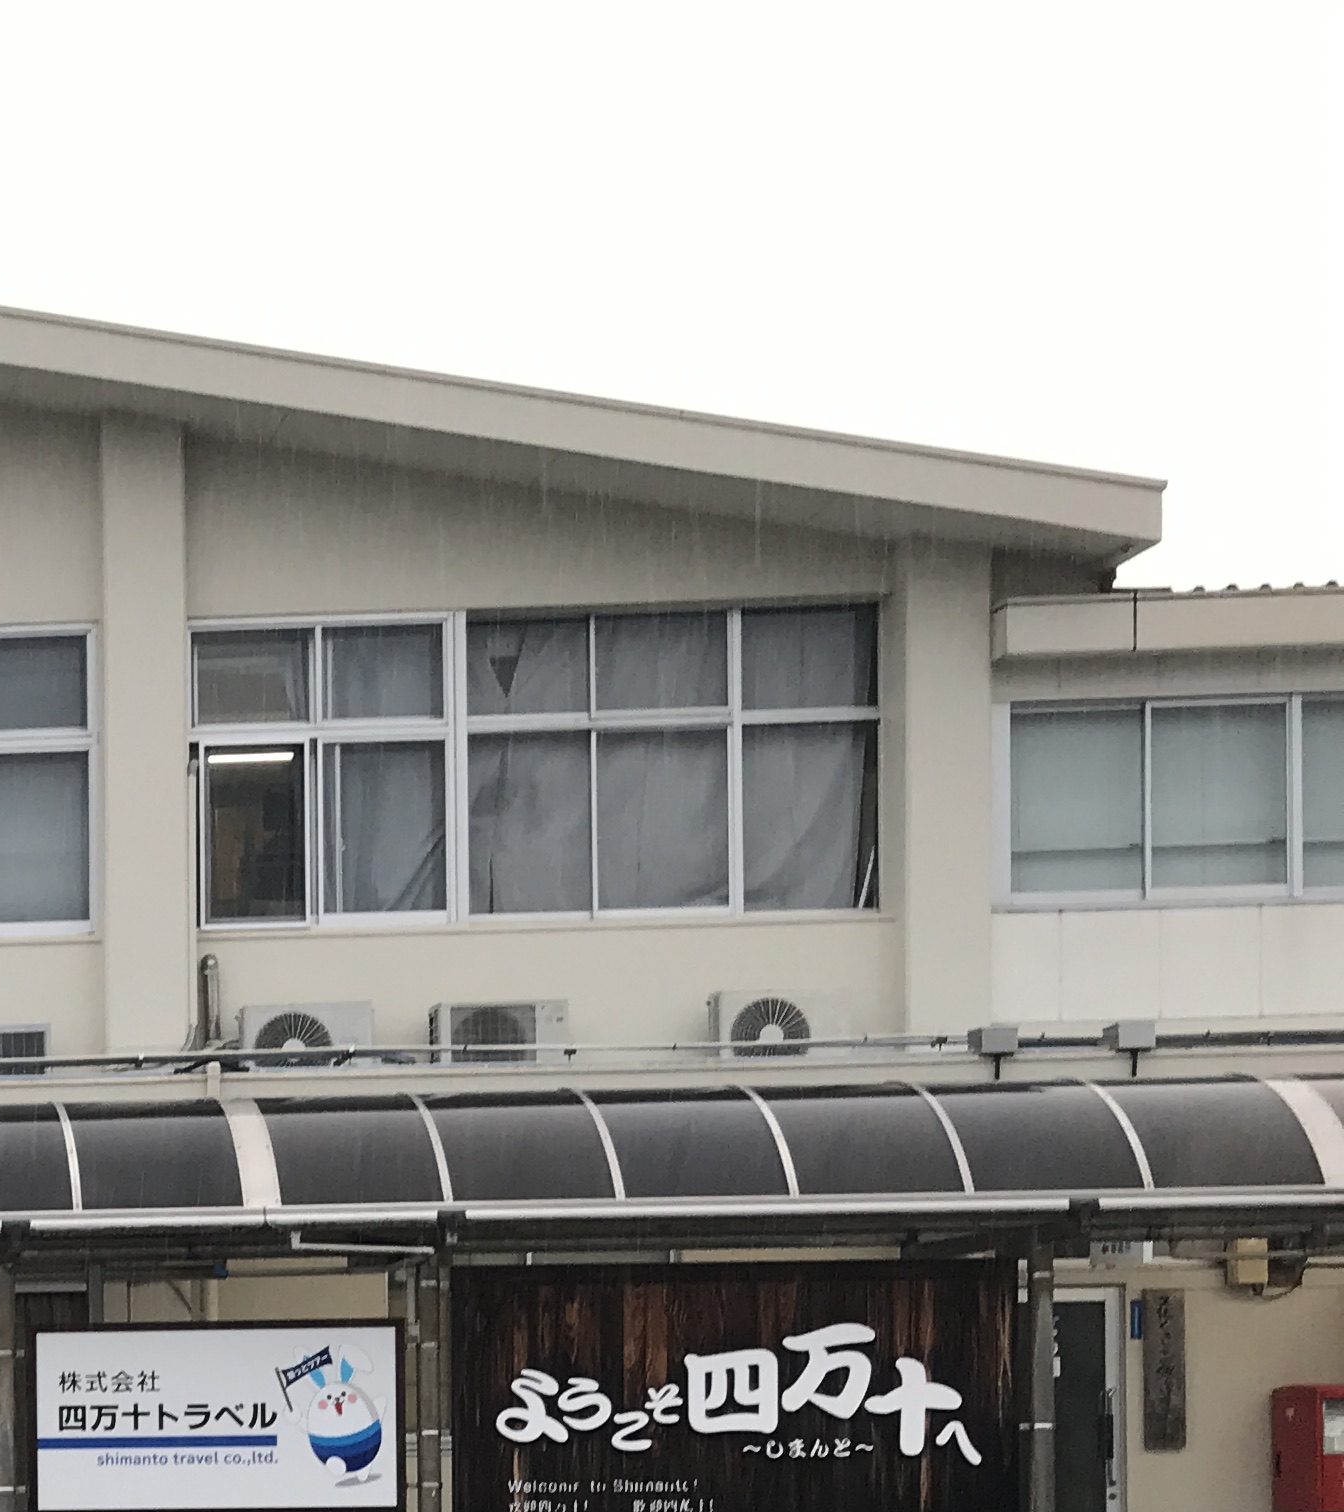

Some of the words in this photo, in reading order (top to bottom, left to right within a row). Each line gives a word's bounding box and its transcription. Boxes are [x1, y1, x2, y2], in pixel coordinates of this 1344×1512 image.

[58, 1370, 161, 1394] 株式会社
[495, 1322, 983, 1466] ようこそ四万十へ
[58, 1402, 278, 1433] 四万十トラベル
[96, 1451, 169, 1467] shimanto
[173, 1450, 219, 1466] travel
